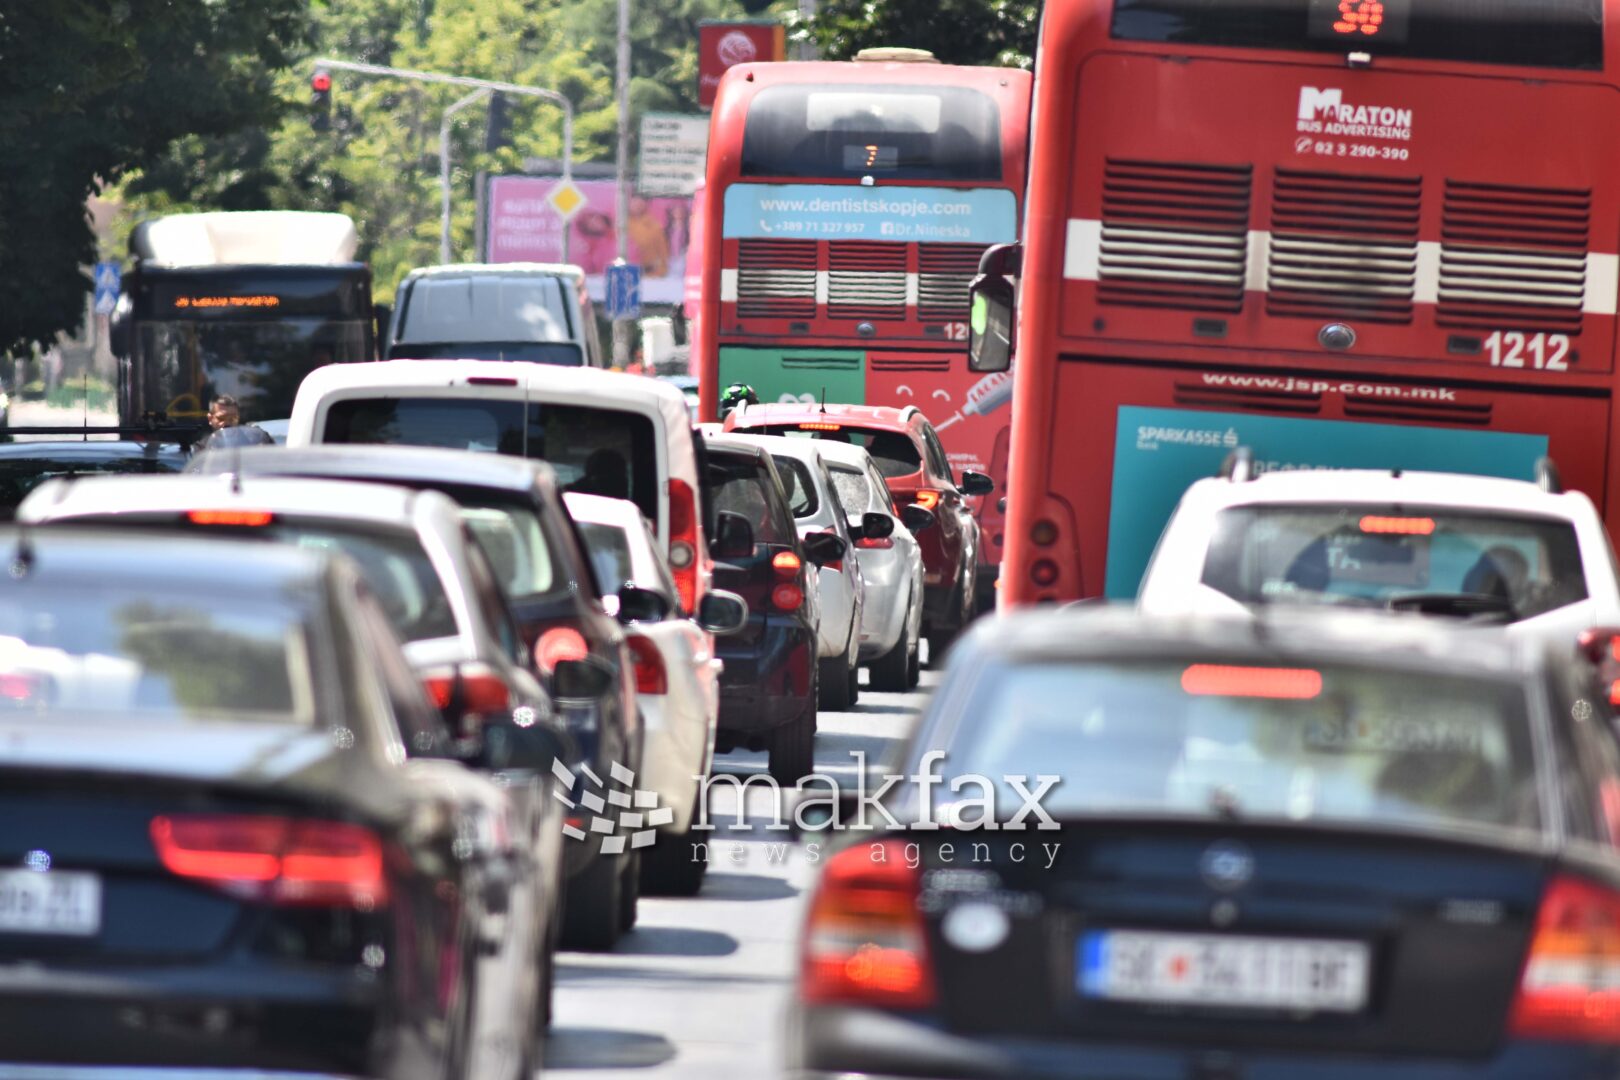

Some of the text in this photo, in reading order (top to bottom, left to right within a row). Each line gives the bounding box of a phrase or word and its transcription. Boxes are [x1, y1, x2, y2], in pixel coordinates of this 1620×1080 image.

[1298, 86, 1412, 127] MARATON
[1296, 119, 1411, 140] BUS ADVERTISING
[864, 145, 878, 167] 7
[1314, 141, 1333, 155] 02
[1350, 144, 1409, 160] 290-390
[760, 198, 972, 217] www.dentistskopje.com
[774, 220, 865, 233] +389 71 327 957
[895, 222, 971, 238] Dr.Nineska
[1484, 331, 1570, 371] 1212
[1202, 373, 1456, 400] www.jsp.com.mk
[1137, 426, 1222, 446] SPARKASSE
